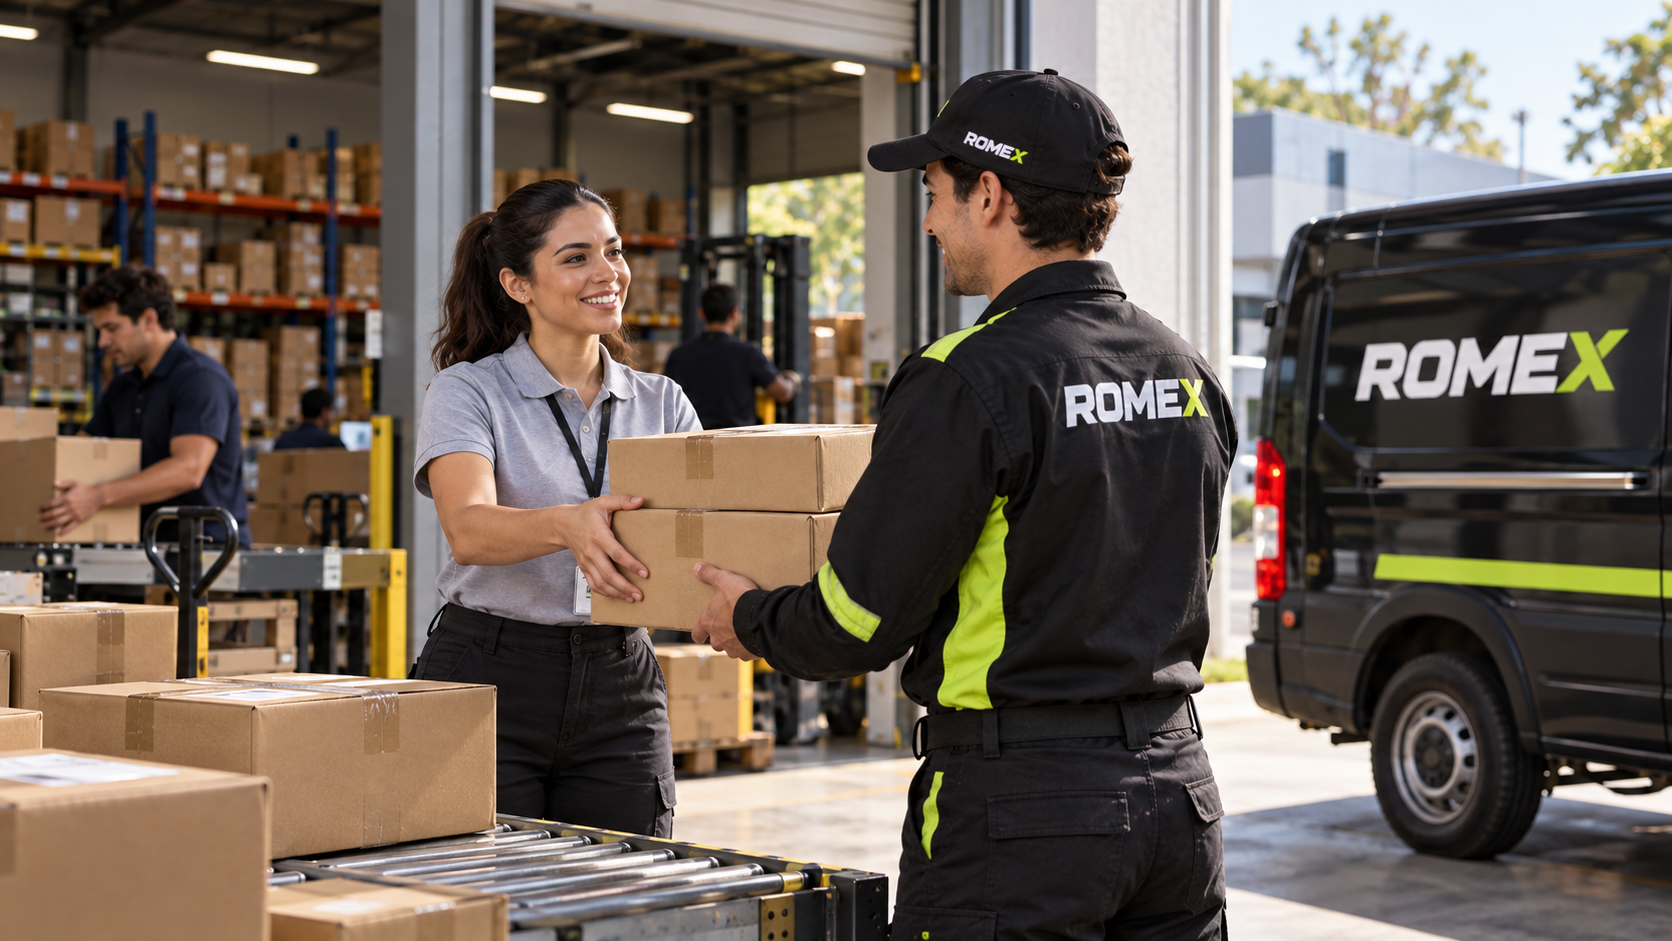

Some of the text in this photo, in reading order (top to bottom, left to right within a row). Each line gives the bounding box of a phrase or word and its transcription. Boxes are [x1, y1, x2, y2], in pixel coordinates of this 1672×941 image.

[963, 131, 1029, 165] ROMEX
[1354, 328, 1629, 403] ROMEX
[1064, 379, 1209, 429] ROMEX
